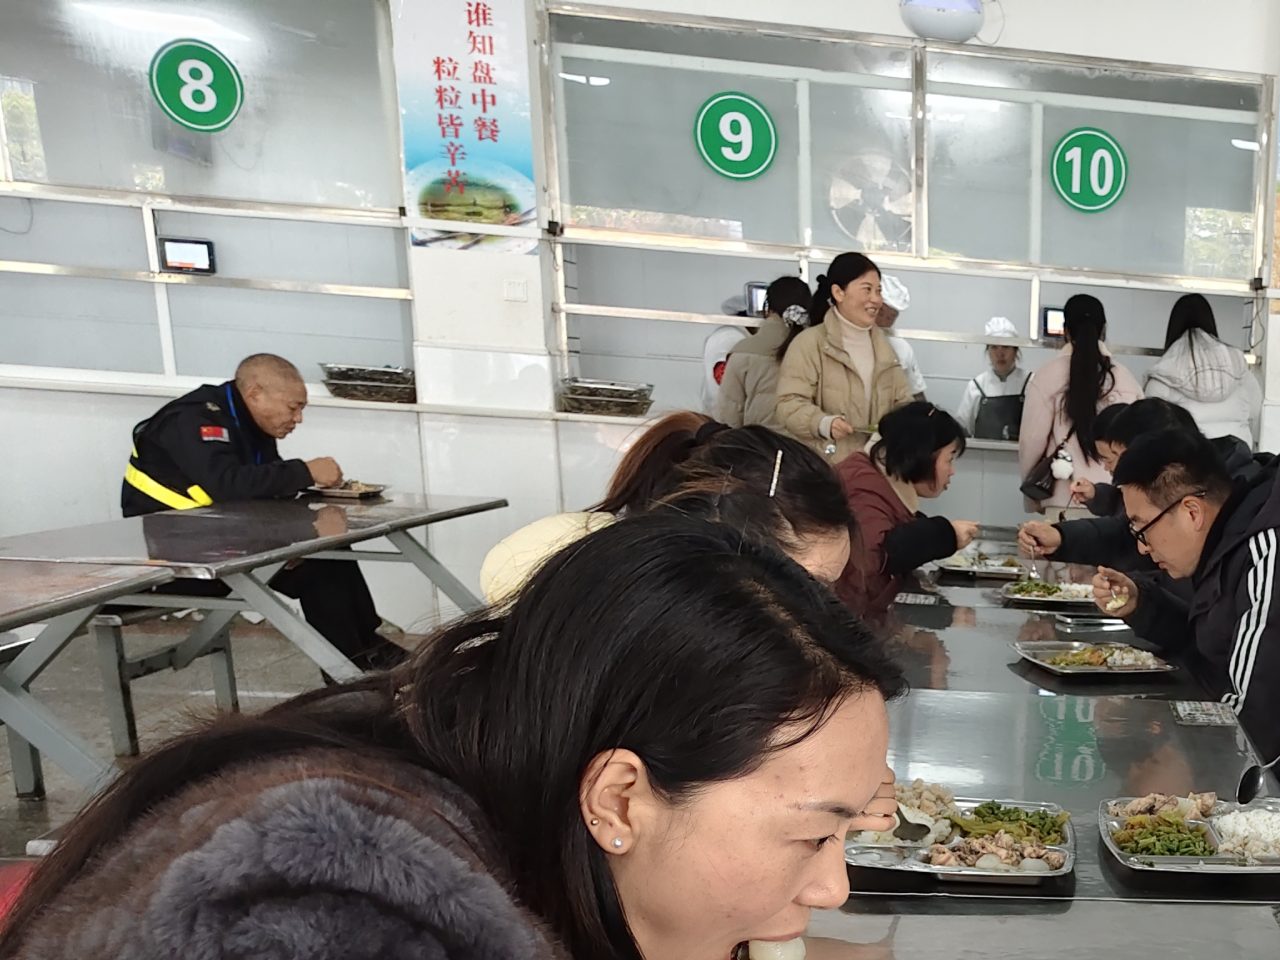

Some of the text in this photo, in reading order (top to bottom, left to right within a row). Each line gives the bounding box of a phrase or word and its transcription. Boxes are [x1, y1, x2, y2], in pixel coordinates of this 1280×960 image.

[178, 59, 217, 112] 8
[465, 1, 500, 143] 谁知盘中餐
[433, 56, 468, 195] 粒粒皆辛苦
[719, 111, 752, 161] 9
[1065, 146, 1114, 196] 10
